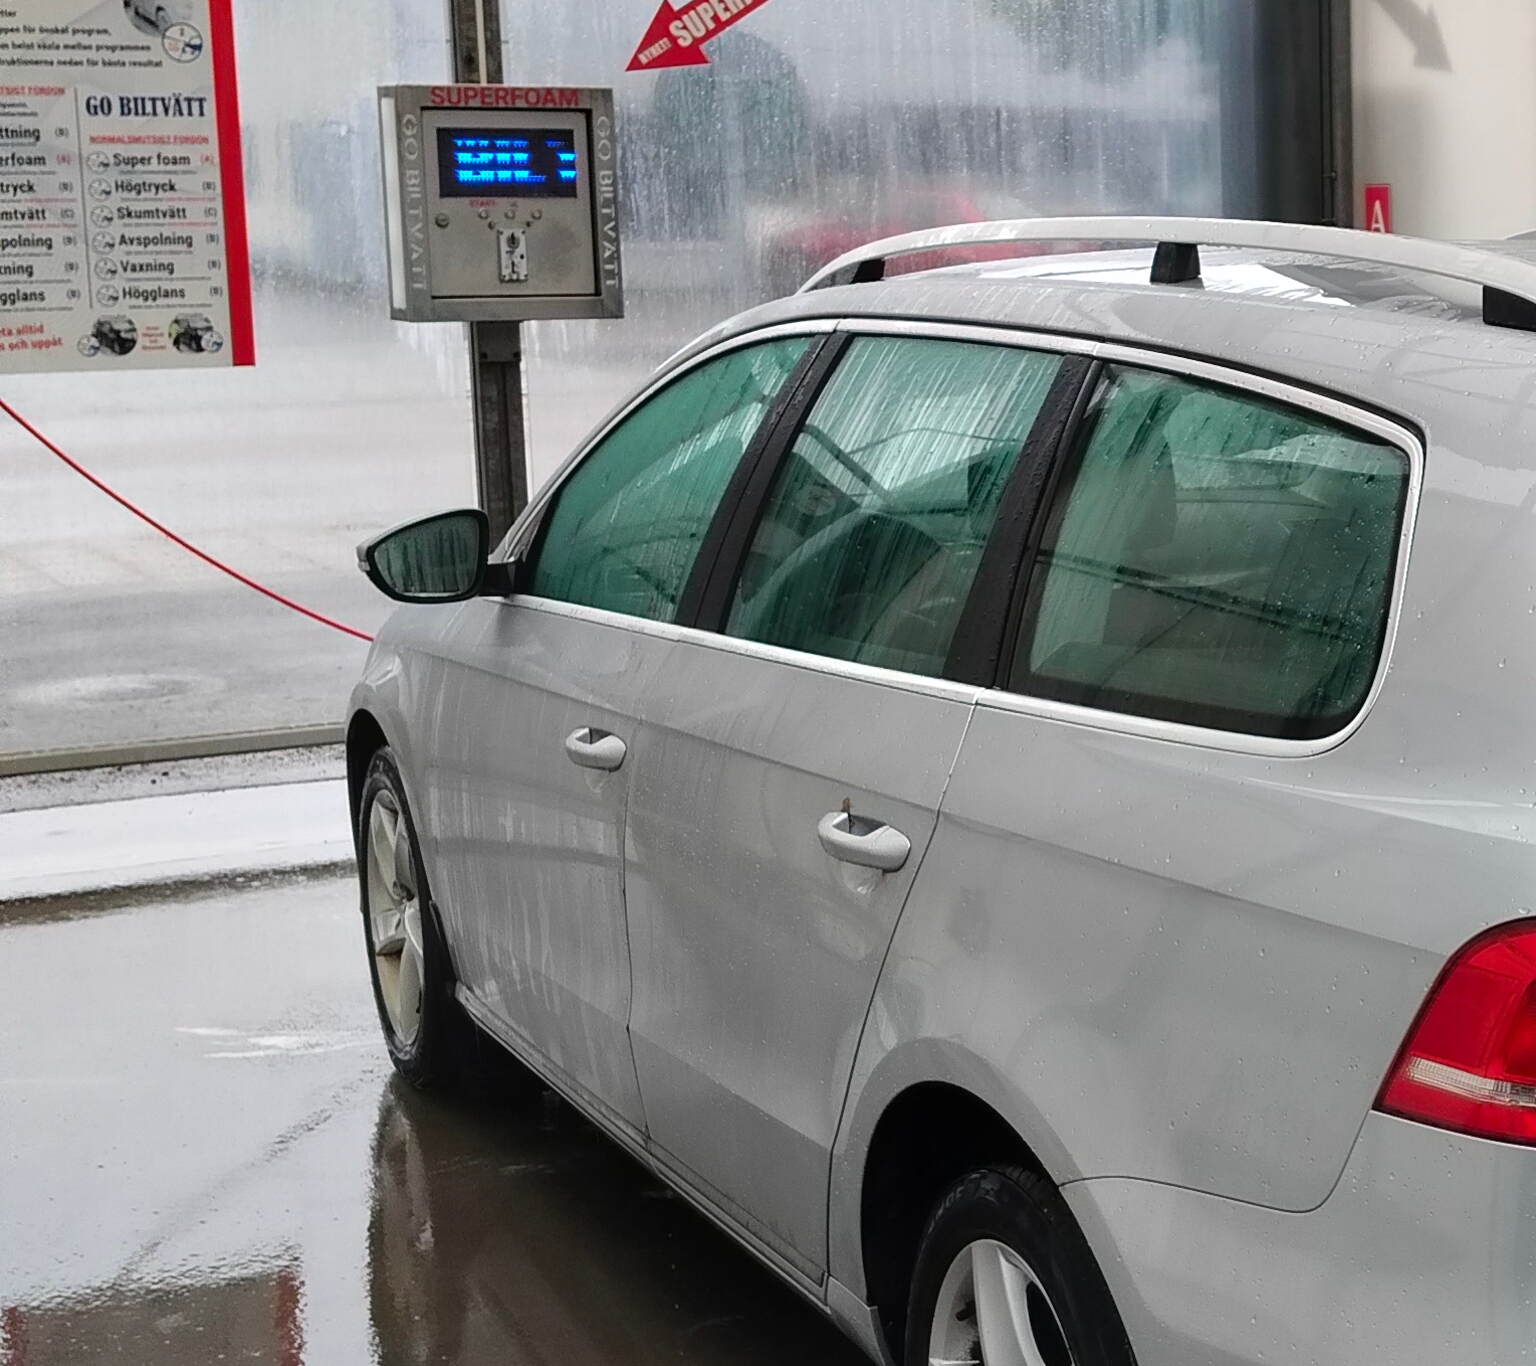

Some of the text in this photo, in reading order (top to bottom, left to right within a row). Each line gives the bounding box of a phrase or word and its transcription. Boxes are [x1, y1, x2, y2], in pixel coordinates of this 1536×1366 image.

[85, 92, 207, 117] GO BILTVÄTT
[429, 86, 579, 107] SUPERFOAM
[402, 113, 419, 161] GO
[596, 115, 612, 161] GO
[113, 153, 152, 168] Super
[157, 151, 191, 166] foam
[115, 178, 177, 196] Högtryck
[116, 205, 187, 220] Skumtvätt
[1371, 199, 1385, 234] A
[119, 232, 193, 248] Avspolning
[120, 258, 175, 275] Vaxning
[122, 285, 186, 303] Högglans
